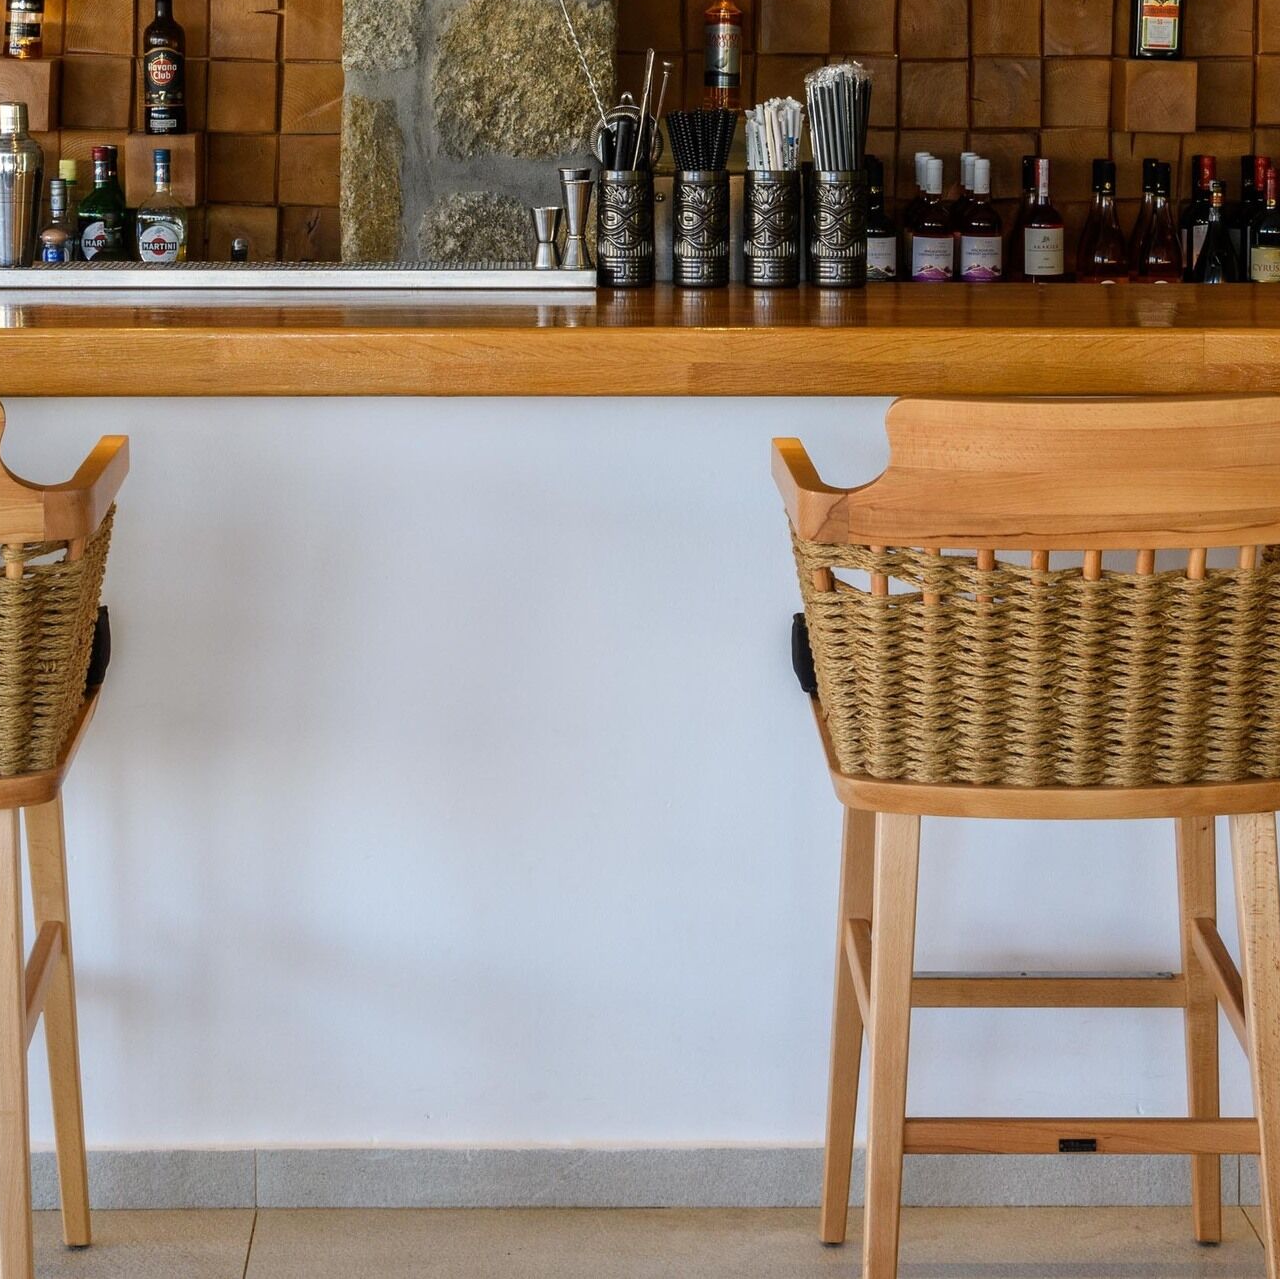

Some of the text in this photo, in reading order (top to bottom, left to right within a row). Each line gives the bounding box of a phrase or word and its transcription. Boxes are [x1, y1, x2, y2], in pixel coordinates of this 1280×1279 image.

[154, 71, 172, 80] Club
[159, 91, 166, 100] 7
[143, 242, 176, 250] MARTINI
